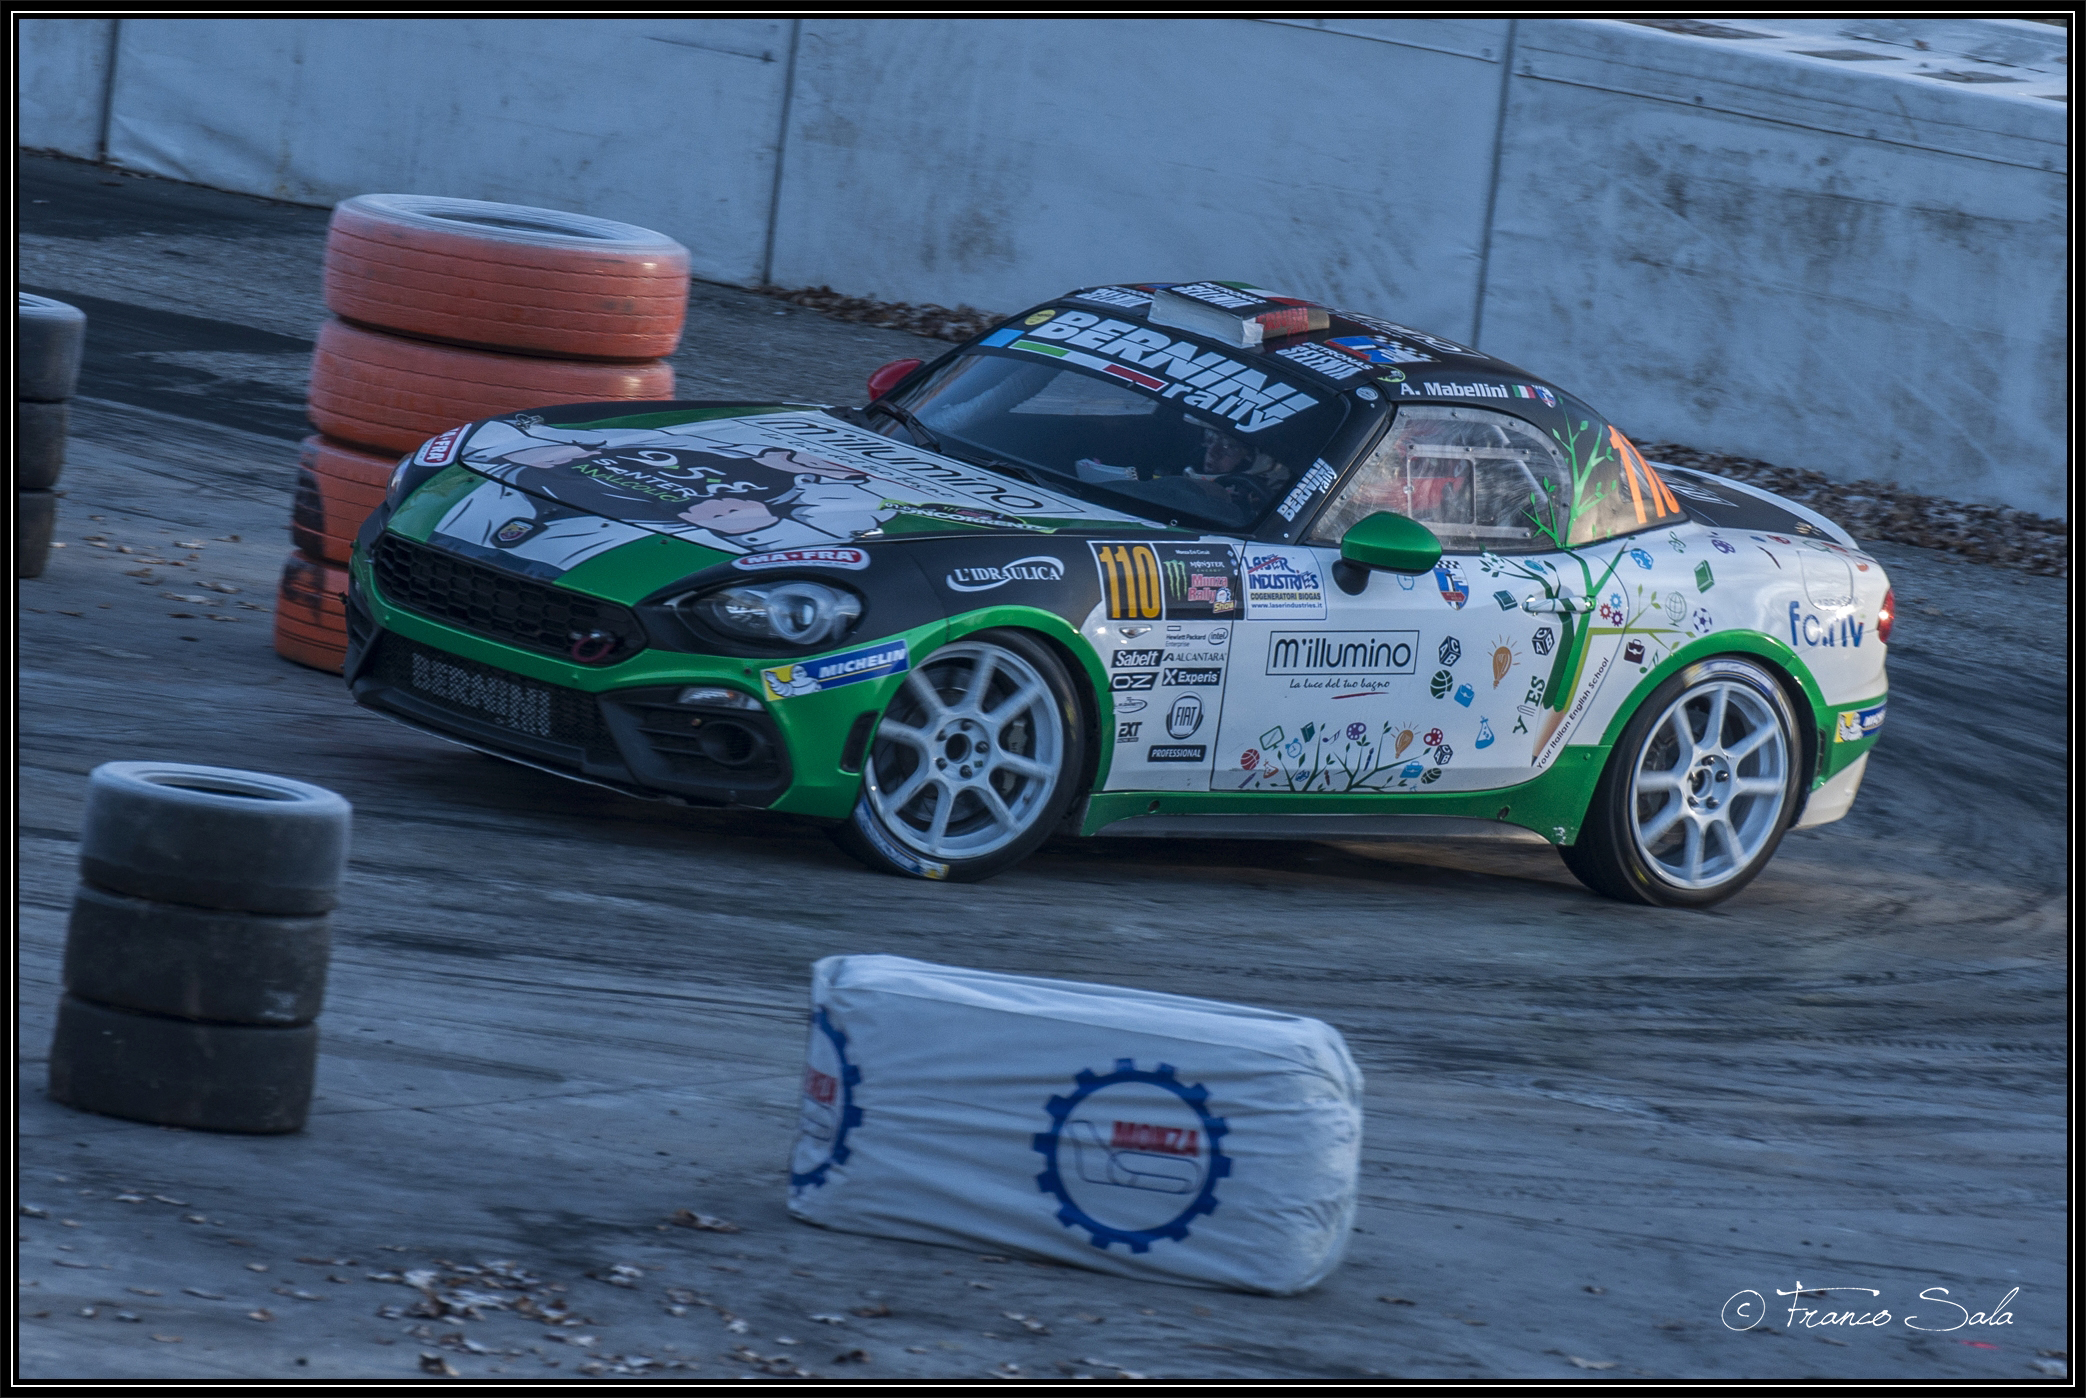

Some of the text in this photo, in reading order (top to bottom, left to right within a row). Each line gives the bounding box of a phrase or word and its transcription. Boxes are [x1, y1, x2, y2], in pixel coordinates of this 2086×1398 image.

[1027, 310, 1319, 421] BERNINI
[1275, 345, 1363, 380] SELENIA
[1302, 342, 1374, 370] PETRONAS
[1401, 382, 1509, 398] A. Mabellini
[1161, 382, 1285, 433] rally
[754, 420, 1043, 509] m'illumino
[1276, 457, 1332, 522] BERNINI
[1318, 466, 1337, 494] rally
[954, 566, 1061, 581] L'IDRAULICA
[1243, 554, 1296, 574] LASER
[1099, 546, 1161, 619] 110
[1188, 587, 1217, 604] Rally
[1250, 592, 1322, 601] COGENERATORI BIOGAS
[1211, 631, 1226, 640] intel
[1115, 650, 1159, 666] Sabelt
[1175, 652, 1226, 661] ALCANTARA
[1272, 638, 1411, 668] m'illumino
[818, 648, 907, 679] MICHELIN
[1178, 671, 1218, 684] Experis
[1289, 678, 1391, 691] La luce del tuo bagno
[1174, 707, 1198, 726] FIAT
[1537, 657, 1609, 769] Your Italian English School
[1151, 749, 1201, 757] PROFESSIONAL
